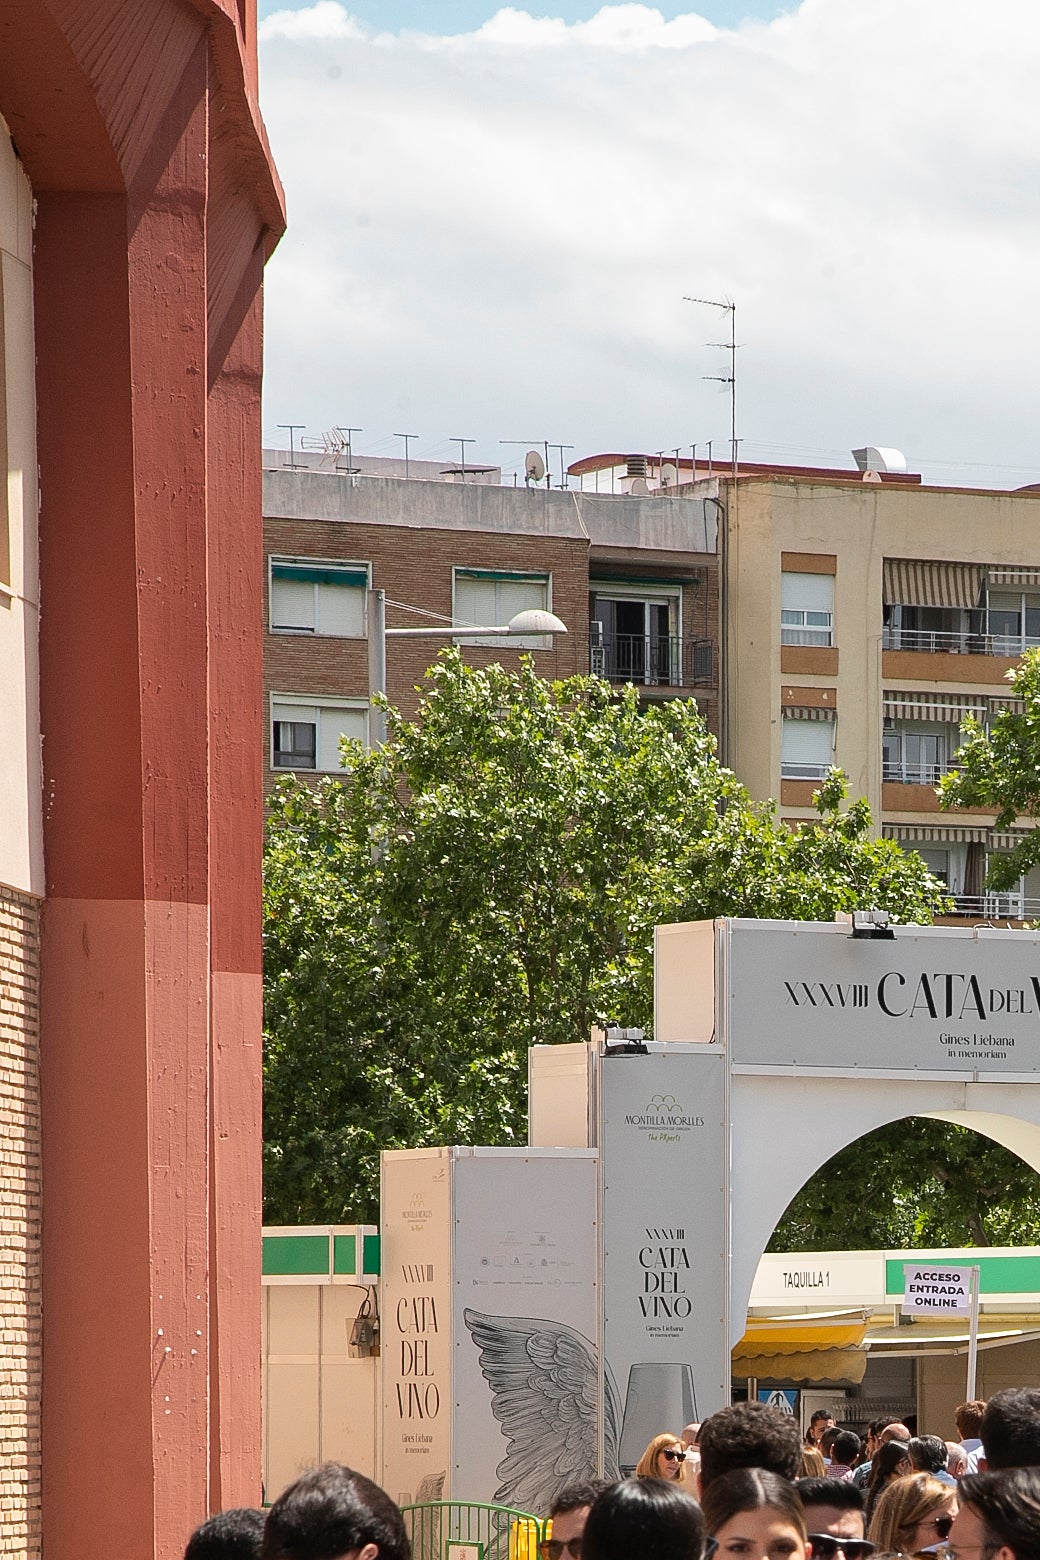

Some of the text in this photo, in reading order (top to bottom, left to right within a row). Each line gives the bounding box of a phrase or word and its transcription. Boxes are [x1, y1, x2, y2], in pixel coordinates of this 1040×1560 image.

[784, 982, 868, 1007] XXXVIII
[877, 971, 987, 1020] CATA
[989, 989, 1032, 1014] DEL
[947, 1048, 1007, 1059] in memoriam
[624, 1115, 666, 1126] MONTILLA
[645, 1228, 685, 1240] XXXVIII
[639, 1246, 690, 1269] CATA
[644, 1271, 686, 1293] DEL
[783, 1271, 830, 1288] TAQUILLA 1
[913, 1272, 961, 1282] ACCESO
[909, 1285, 965, 1295] ENTRADA
[638, 1295, 692, 1318] VINO
[915, 1297, 958, 1307] ONLINE
[396, 1296, 438, 1333] CATA
[401, 1340, 434, 1376] DEL
[396, 1383, 439, 1419] VINO
